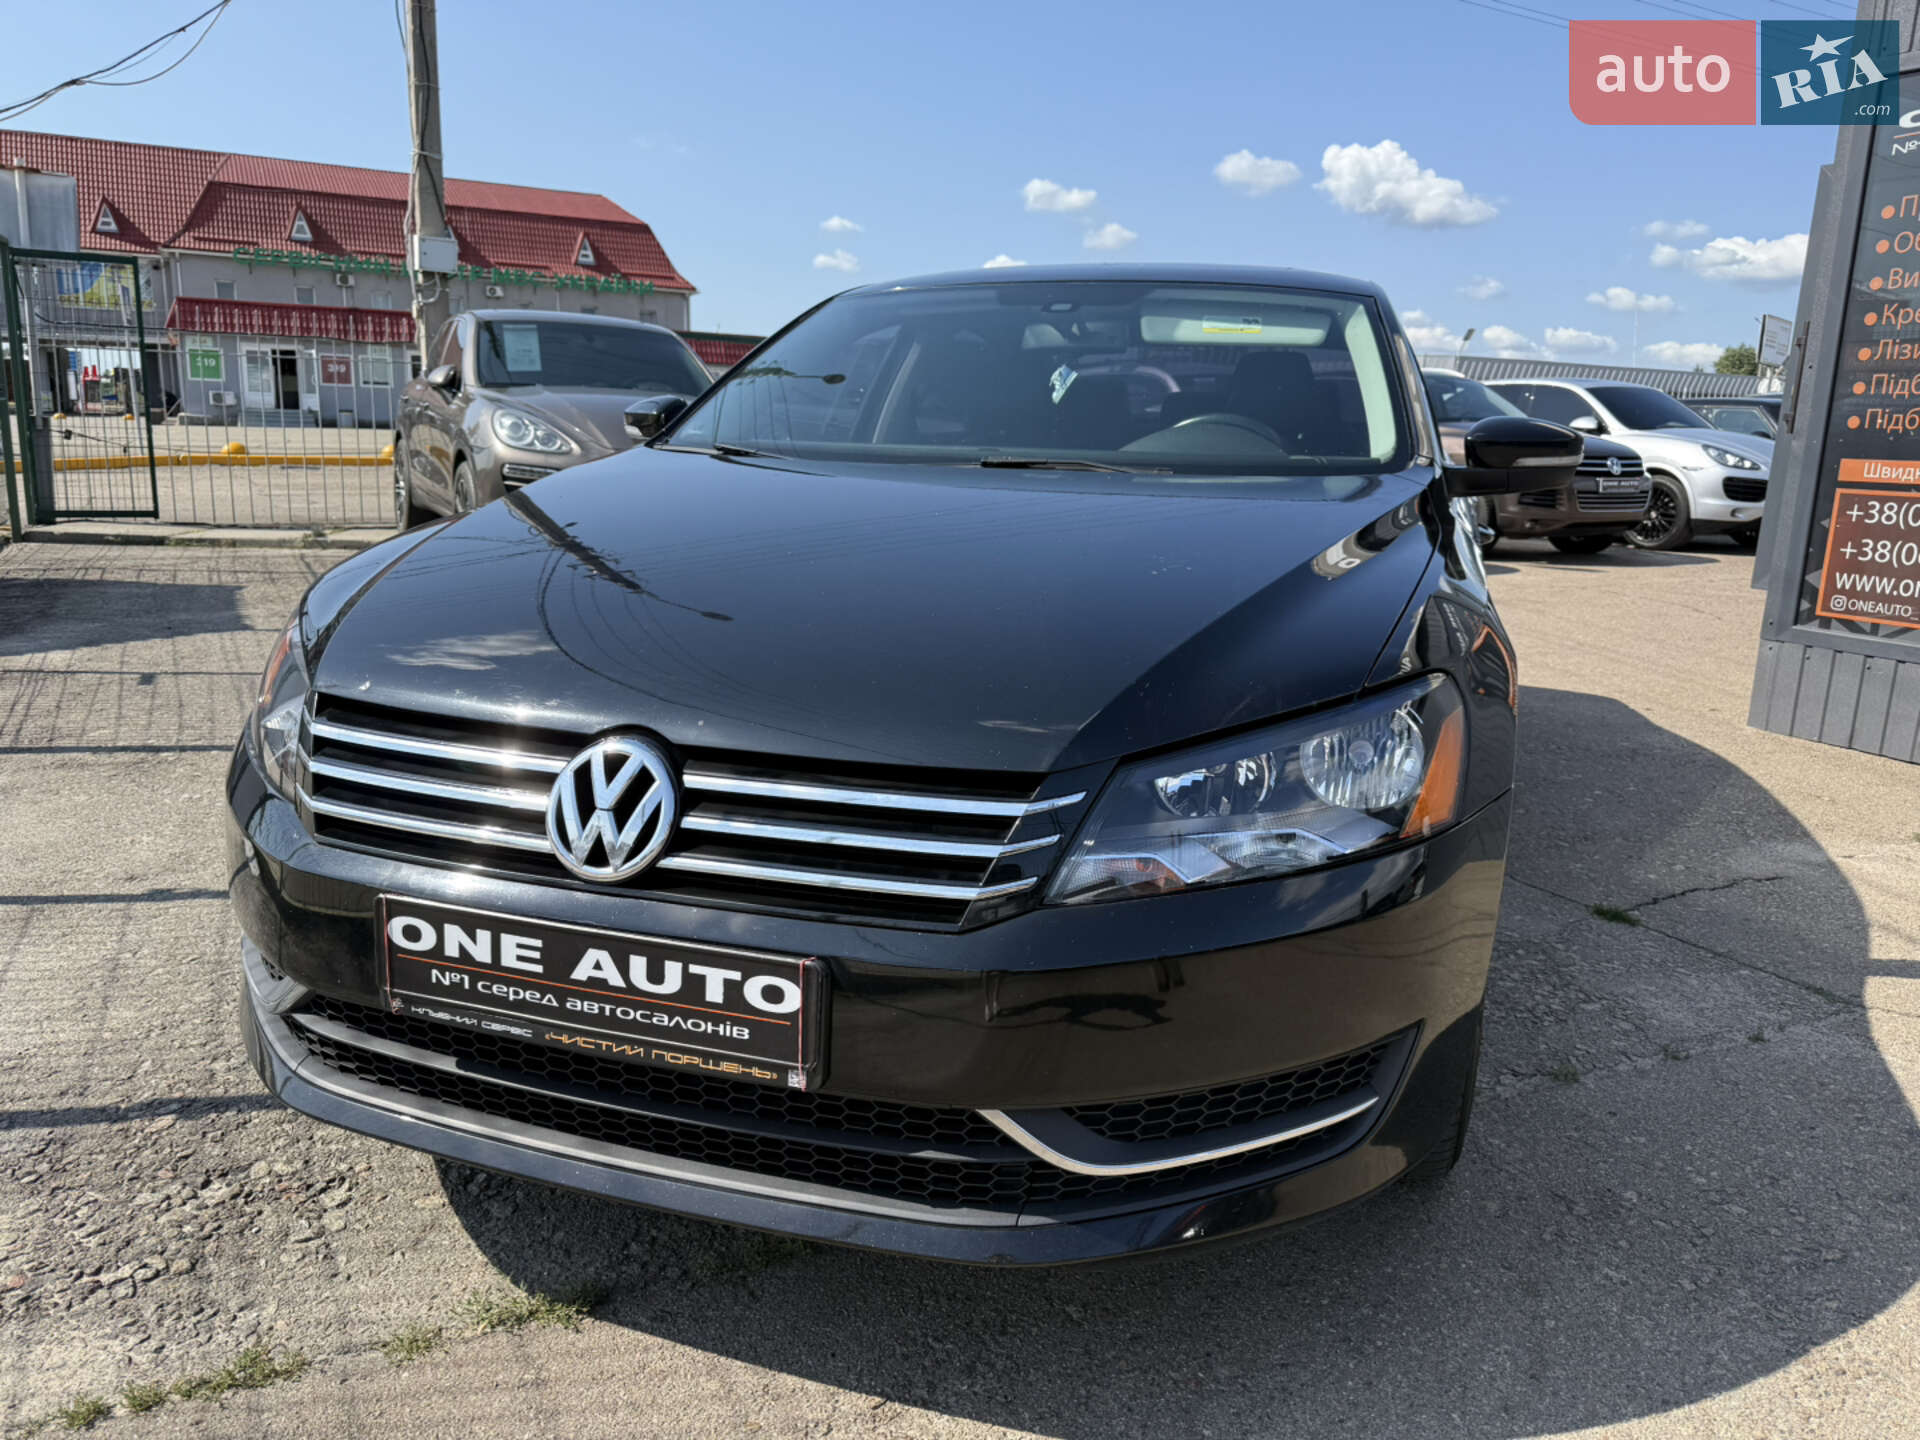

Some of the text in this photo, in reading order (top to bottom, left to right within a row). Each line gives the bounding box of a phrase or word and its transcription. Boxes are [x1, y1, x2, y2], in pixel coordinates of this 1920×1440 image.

[1900, 194, 1920, 221] П
[1864, 407, 1920, 434] Підб
[1840, 538, 1920, 568] +38(0
[387, 915, 801, 1015] ONE AUTO
[430, 968, 751, 1040] №1 серед автосалонів
